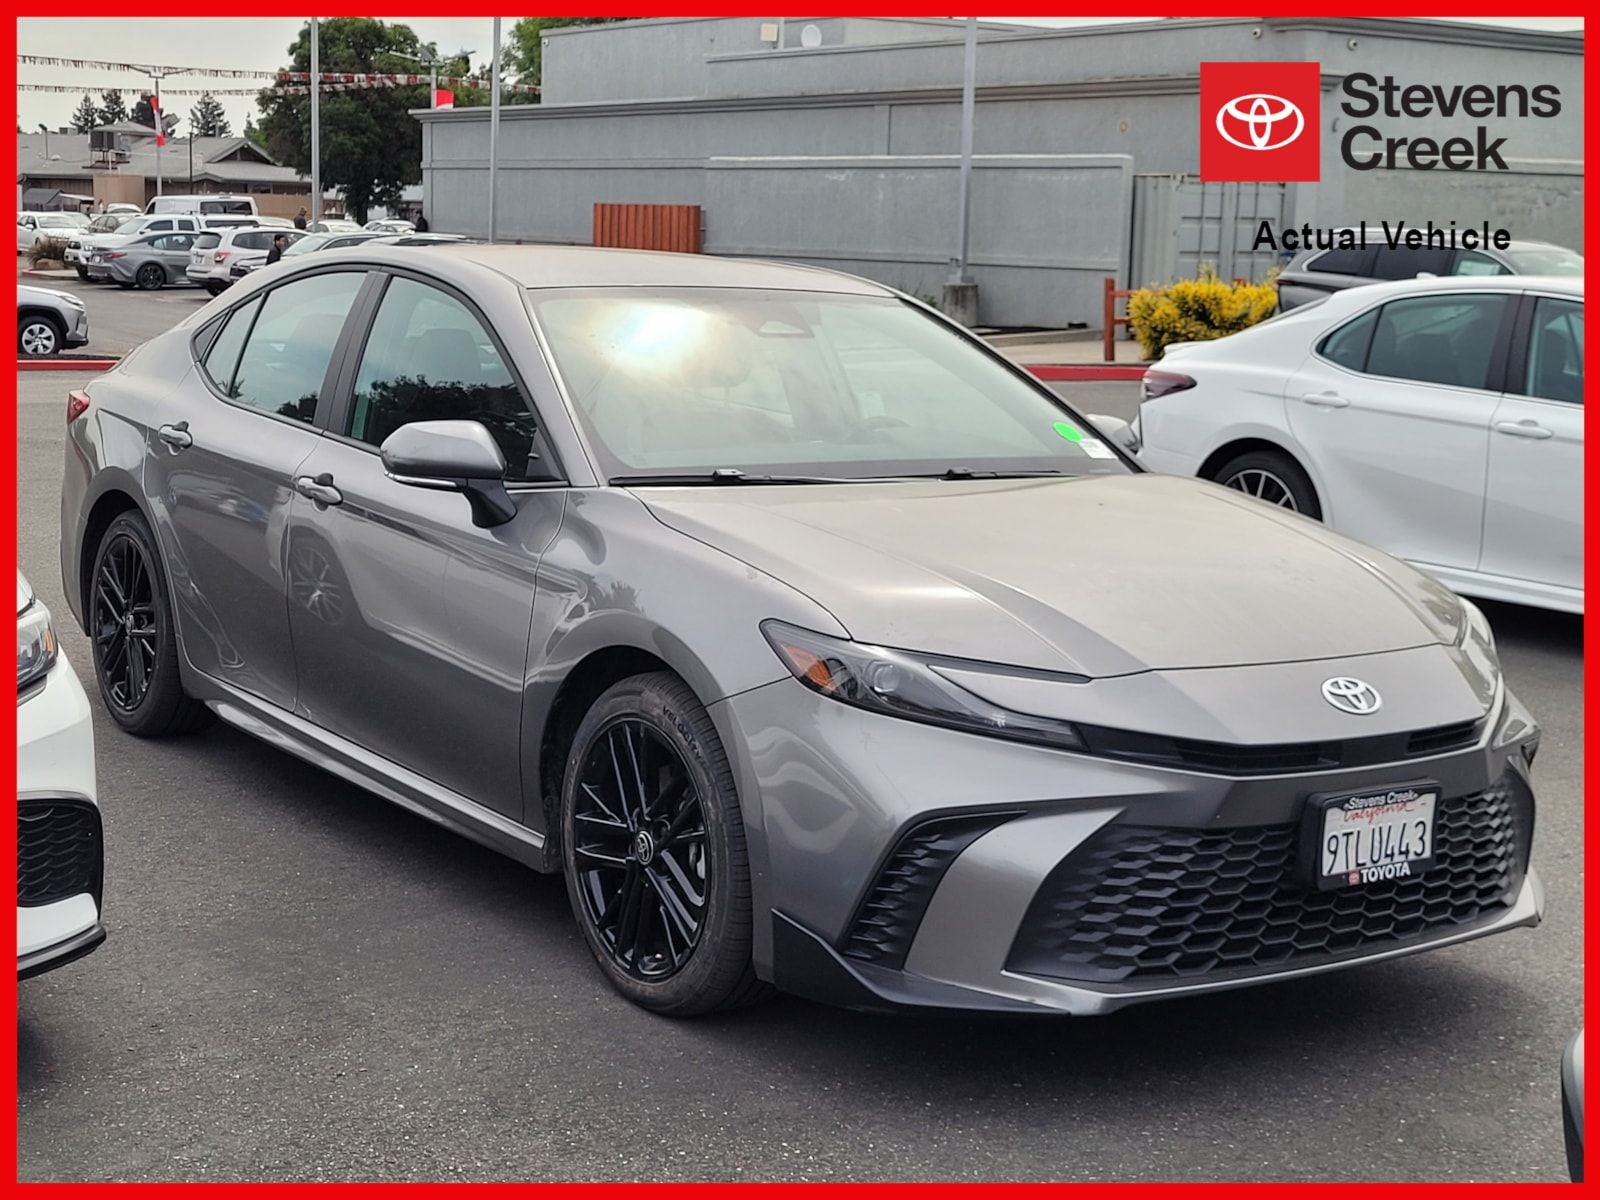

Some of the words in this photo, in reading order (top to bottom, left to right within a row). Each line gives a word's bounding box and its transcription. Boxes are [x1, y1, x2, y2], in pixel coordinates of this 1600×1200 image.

[1348, 796, 1386, 810] Stevens
[1386, 789, 1416, 804] Creek
[1326, 820, 1427, 875] 9TLU443
[1360, 861, 1411, 884] TOYOTA
